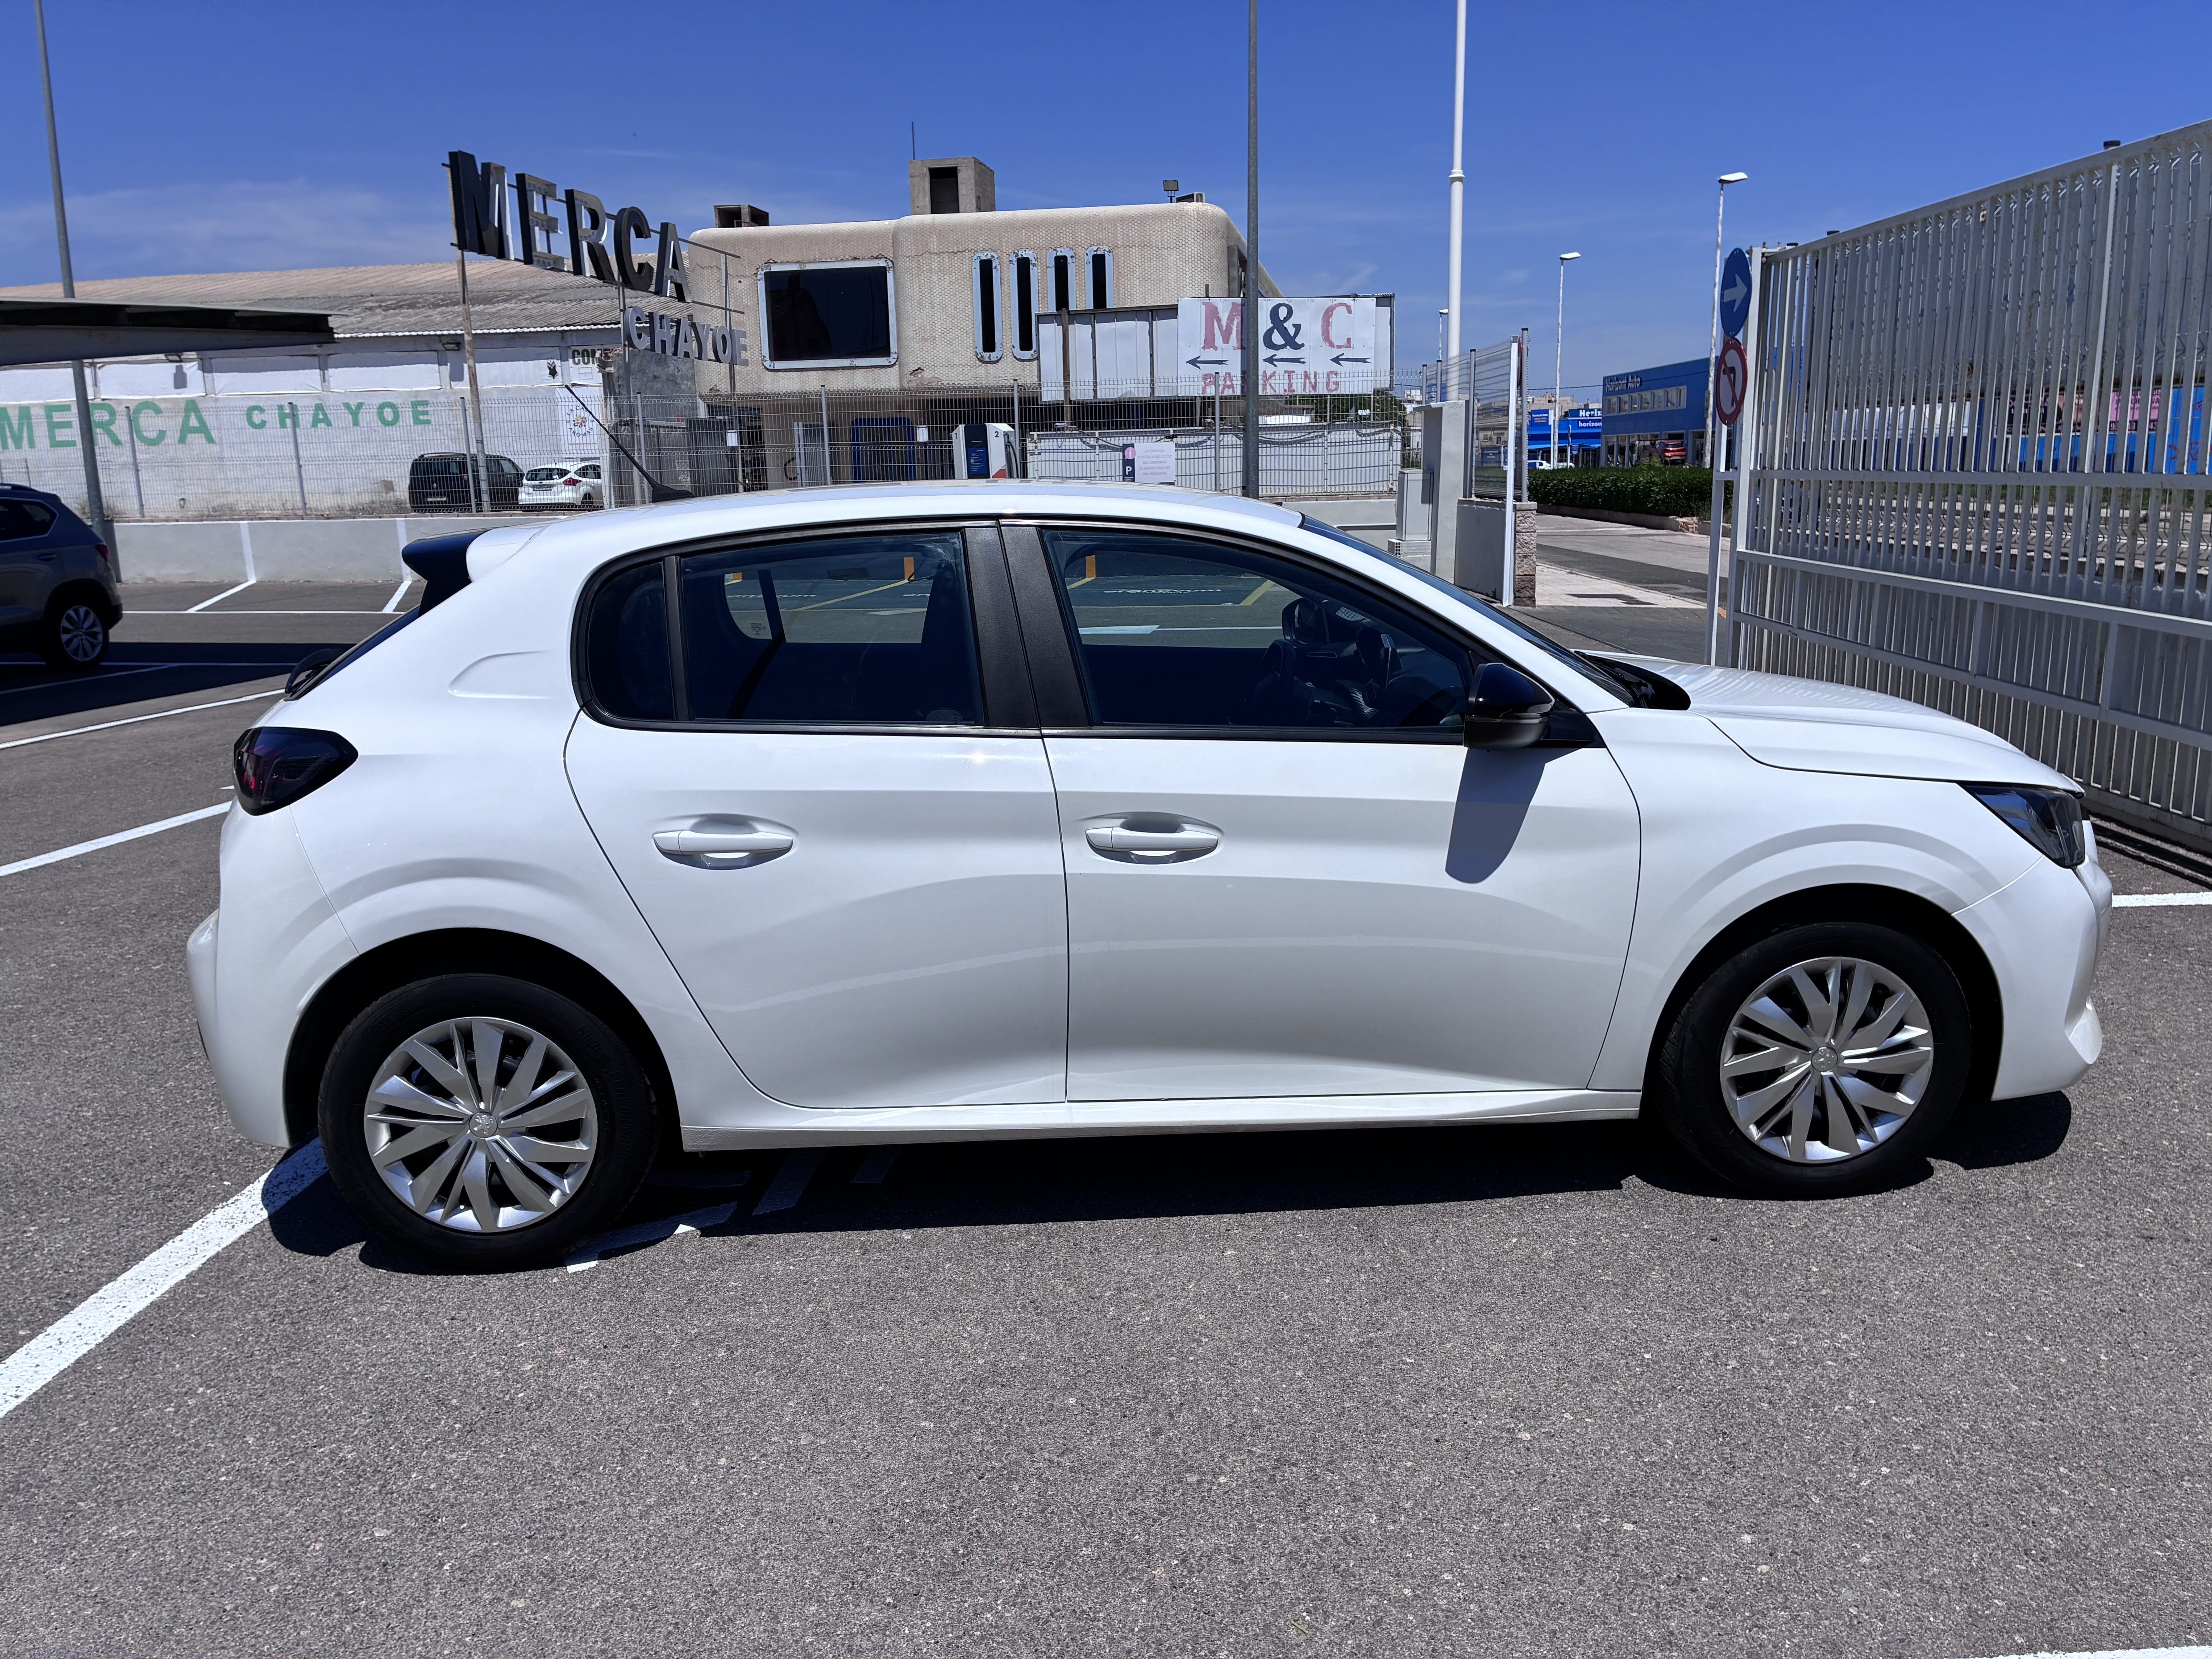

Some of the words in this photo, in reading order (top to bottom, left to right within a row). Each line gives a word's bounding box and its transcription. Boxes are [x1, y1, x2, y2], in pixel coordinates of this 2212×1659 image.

[449, 150, 691, 302] MERCA
[623, 307, 749, 366] CHAYOE
[1202, 302, 1246, 351] M
[1263, 303, 1305, 351] &
[1321, 302, 1352, 349] C
[0, 399, 216, 450] MERCA
[246, 400, 431, 429] CHAYOE
[1126, 466, 1132, 475] P
